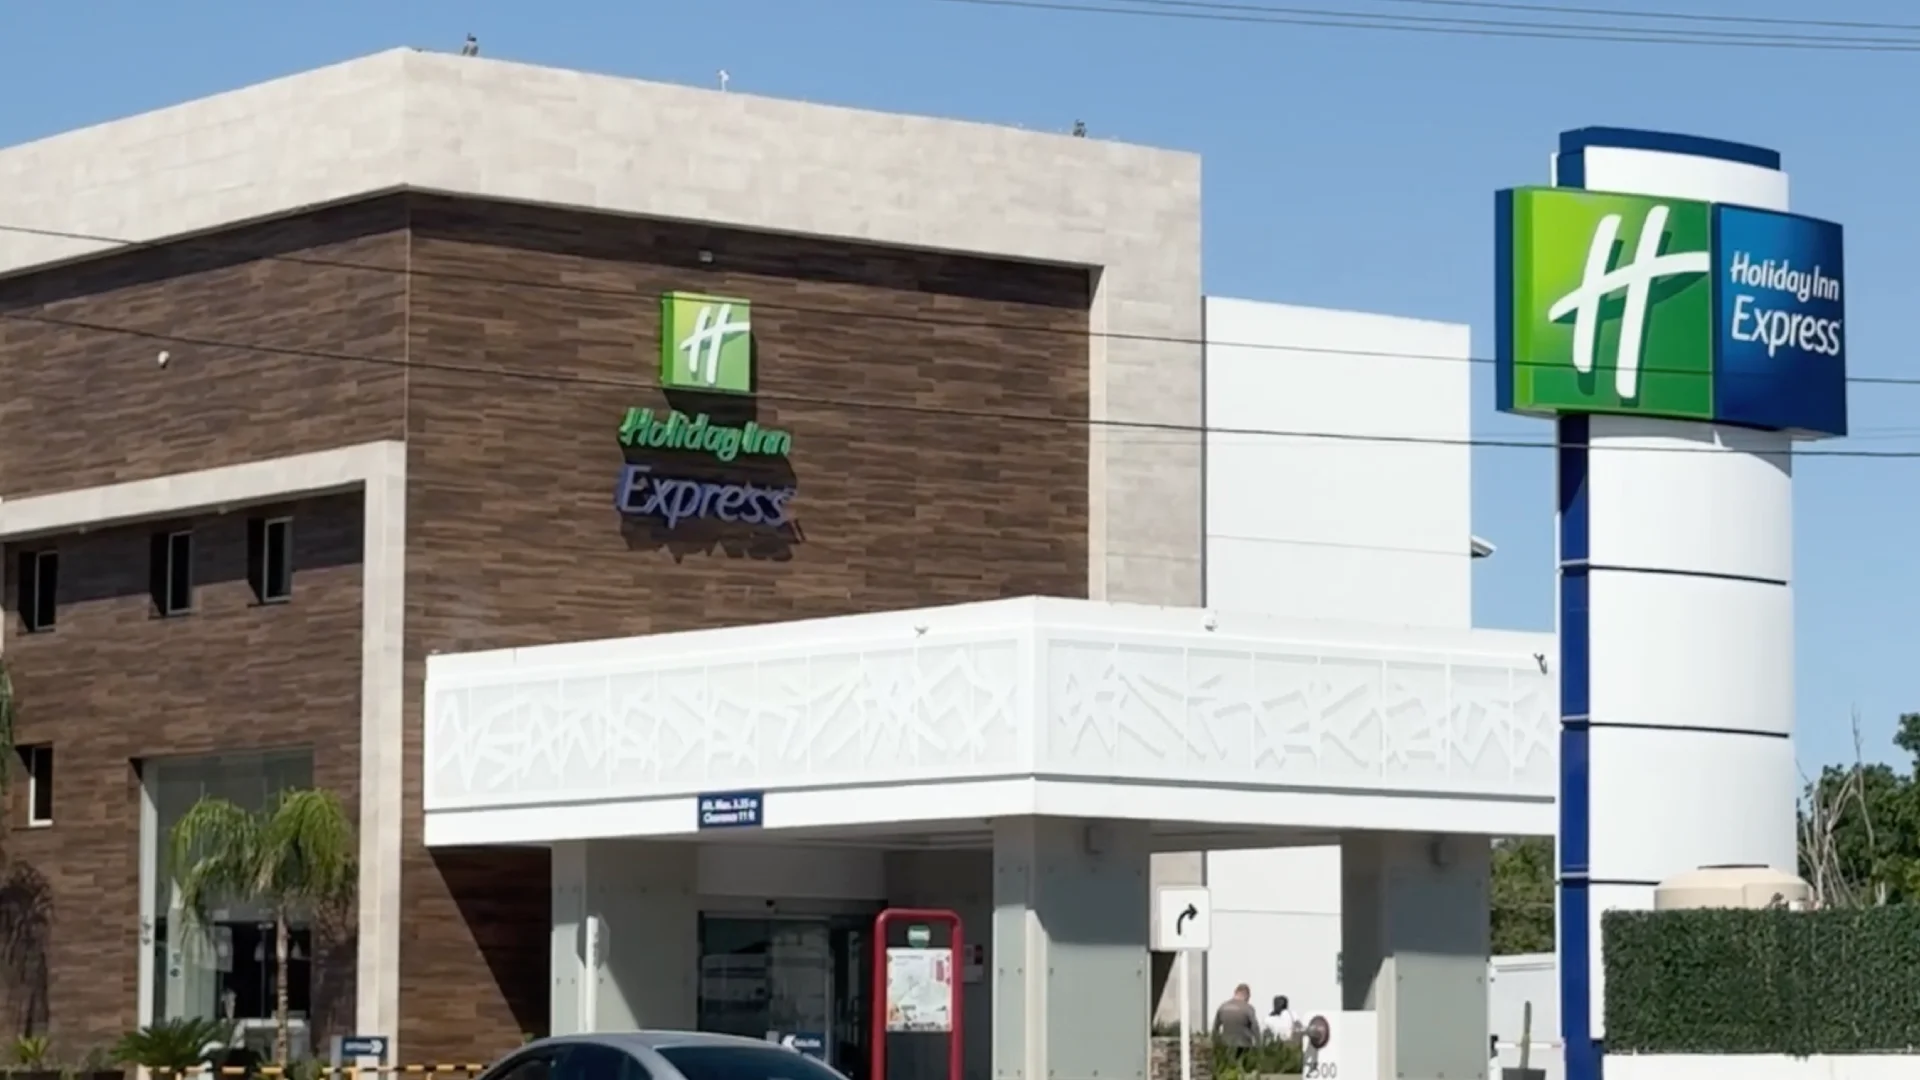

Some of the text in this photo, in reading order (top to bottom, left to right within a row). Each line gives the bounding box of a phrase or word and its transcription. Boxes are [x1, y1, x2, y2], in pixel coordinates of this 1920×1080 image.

[1730, 251, 1840, 303] Holiday Inn
[1731, 294, 1840, 358] Express
[619, 407, 792, 462] Holiday Inn
[615, 463, 797, 530] Express
